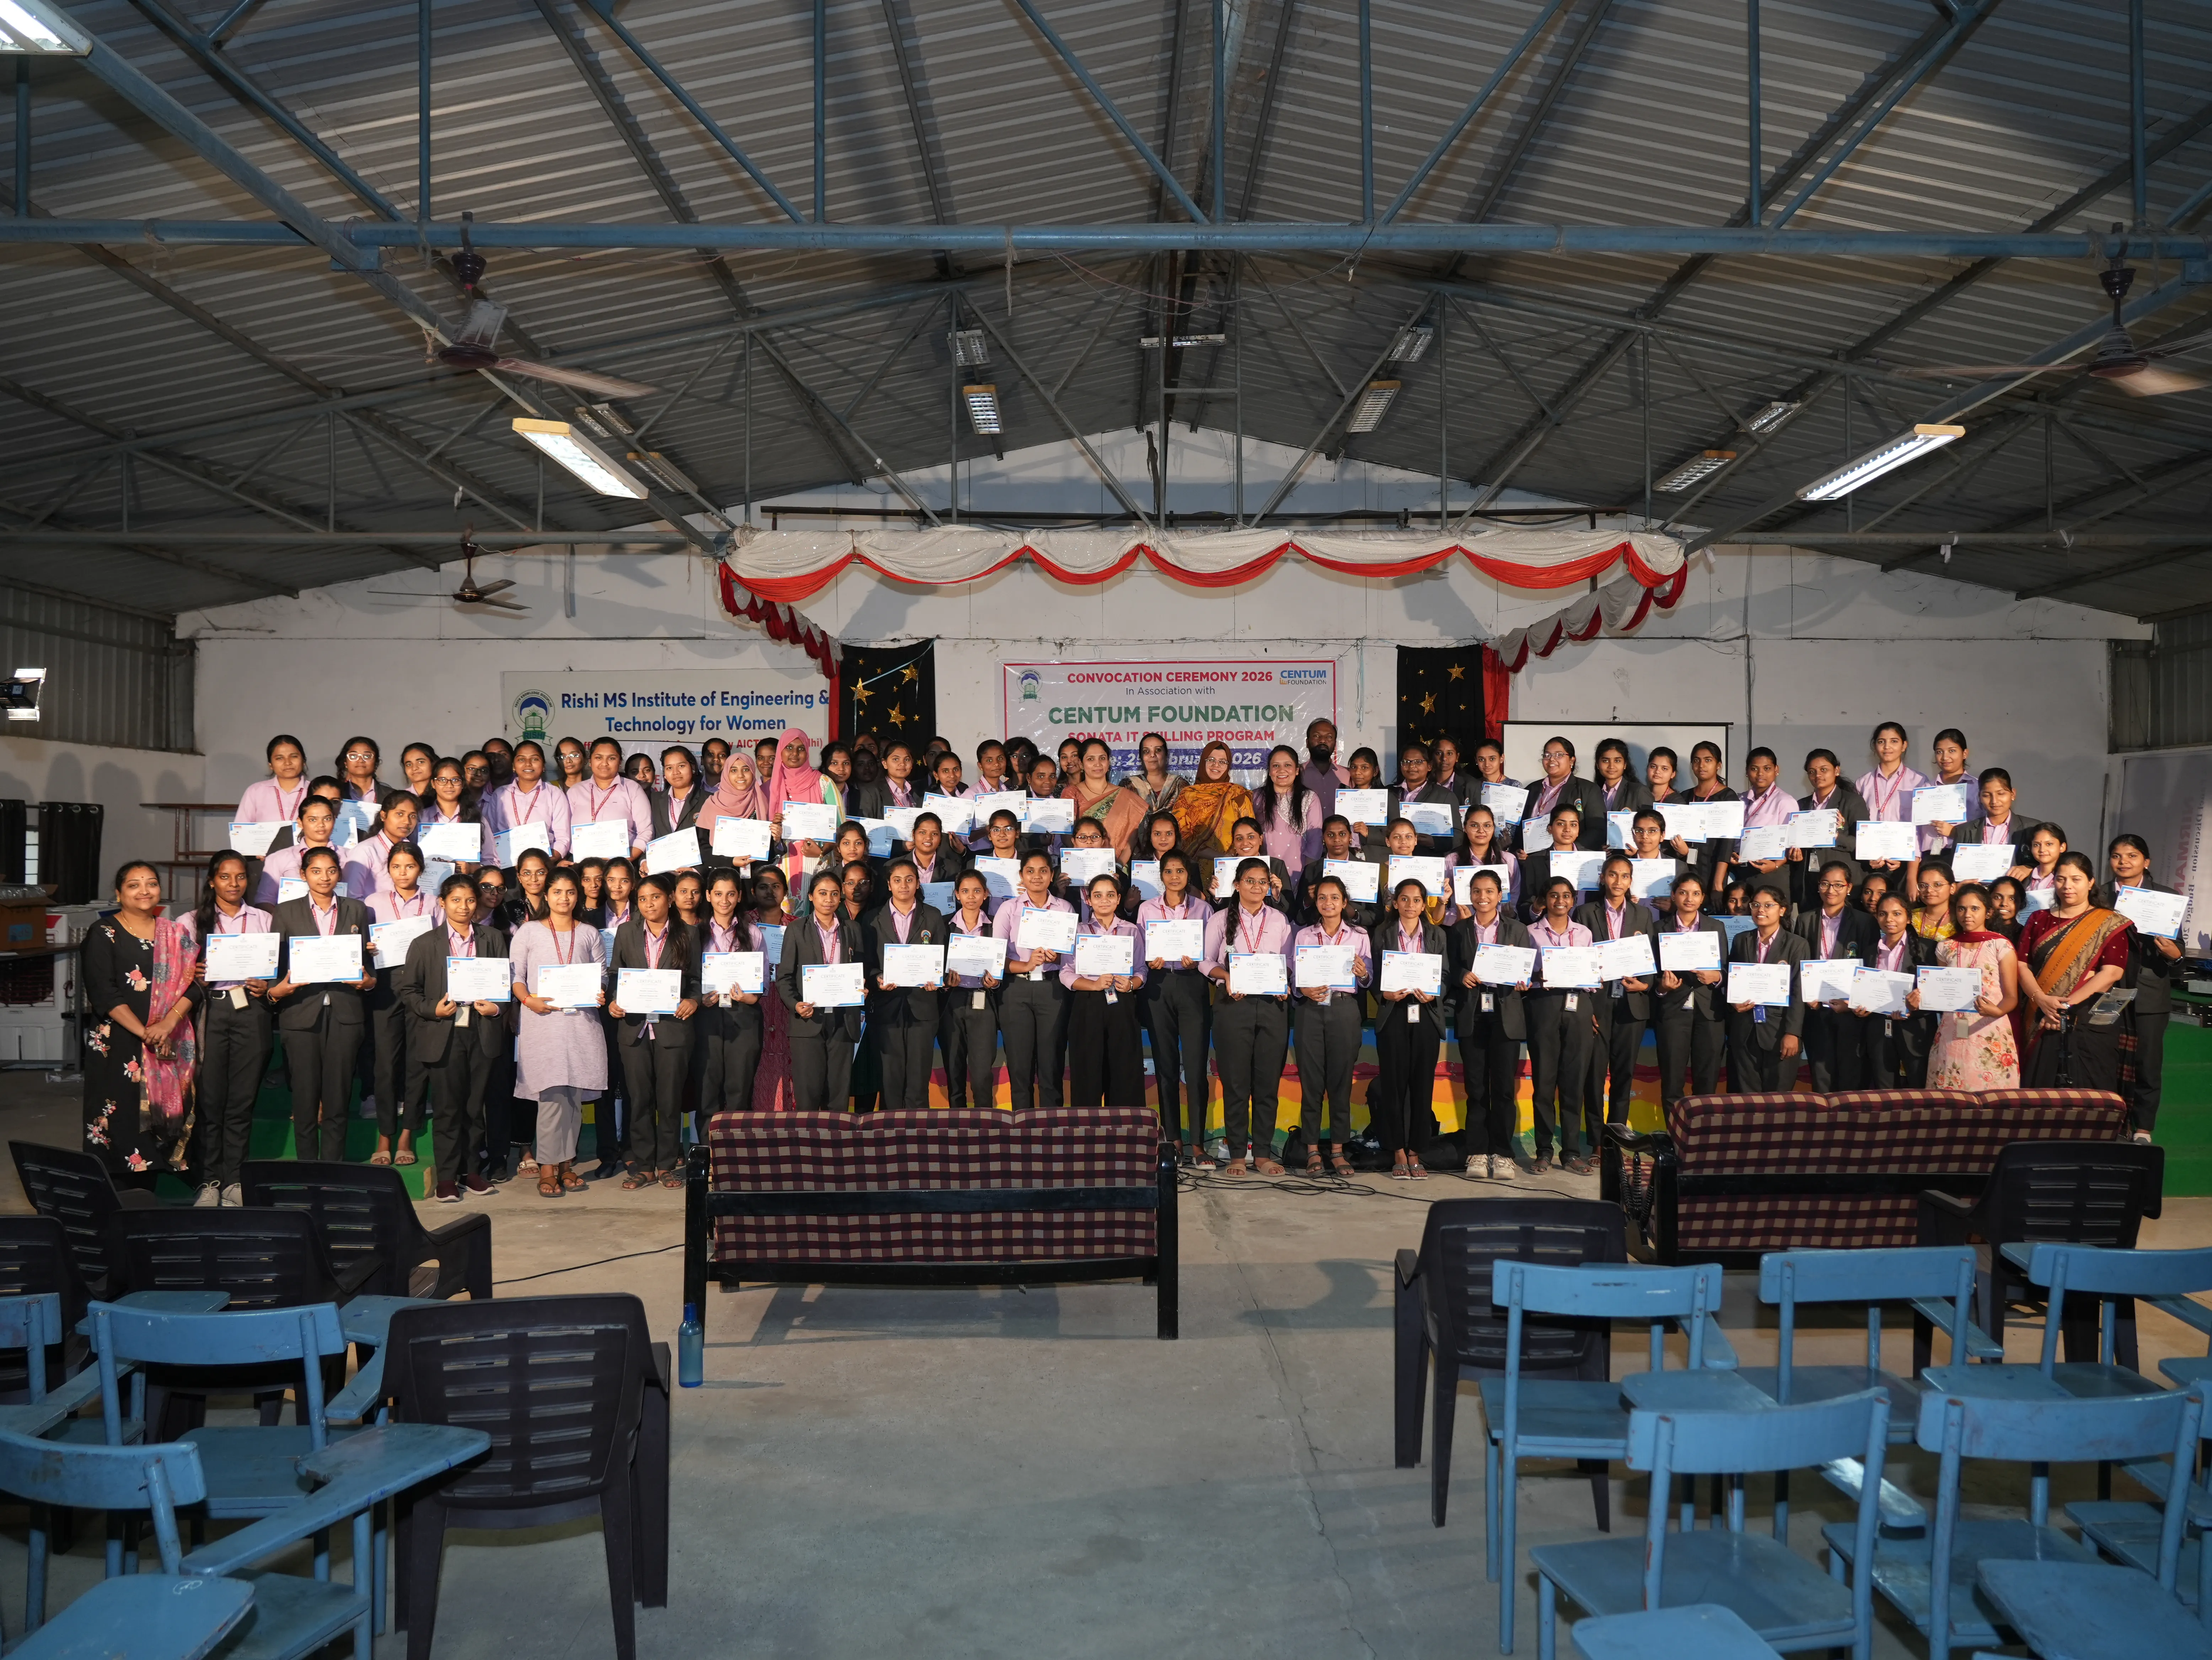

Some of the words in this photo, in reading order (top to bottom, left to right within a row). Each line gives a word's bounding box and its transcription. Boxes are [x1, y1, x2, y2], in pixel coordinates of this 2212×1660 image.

[1068, 672, 1162, 683] CONVOCATION
[1166, 672, 1237, 681] CEREMONY
[1242, 672, 1272, 681] 2026
[1281, 670, 1326, 678] CENTUM
[1138, 686, 1192, 695] Association
[562, 693, 598, 708] Rishi
[604, 692, 627, 707] MS
[632, 691, 696, 707] Institute
[700, 691, 716, 706] of
[721, 690, 814, 710] Engineering
[819, 690, 829, 705] &
[1049, 706, 1140, 724] CENTUM
[1148, 705, 1293, 722] FOUNDATION
[605, 716, 695, 734] Technology
[700, 715, 721, 731] for
[726, 715, 786, 730] Women
[524, 731, 545, 739] RISHI
[1068, 732, 1120, 742] SONATA
[1127, 732, 1138, 742] IT
[1143, 731, 1203, 742] ILLING
[1207, 731, 1274, 741] PROGRAM
[736, 739, 761, 748] AICT
[808, 738, 822, 749] lhi)
[1232, 752, 1262, 765] 026
